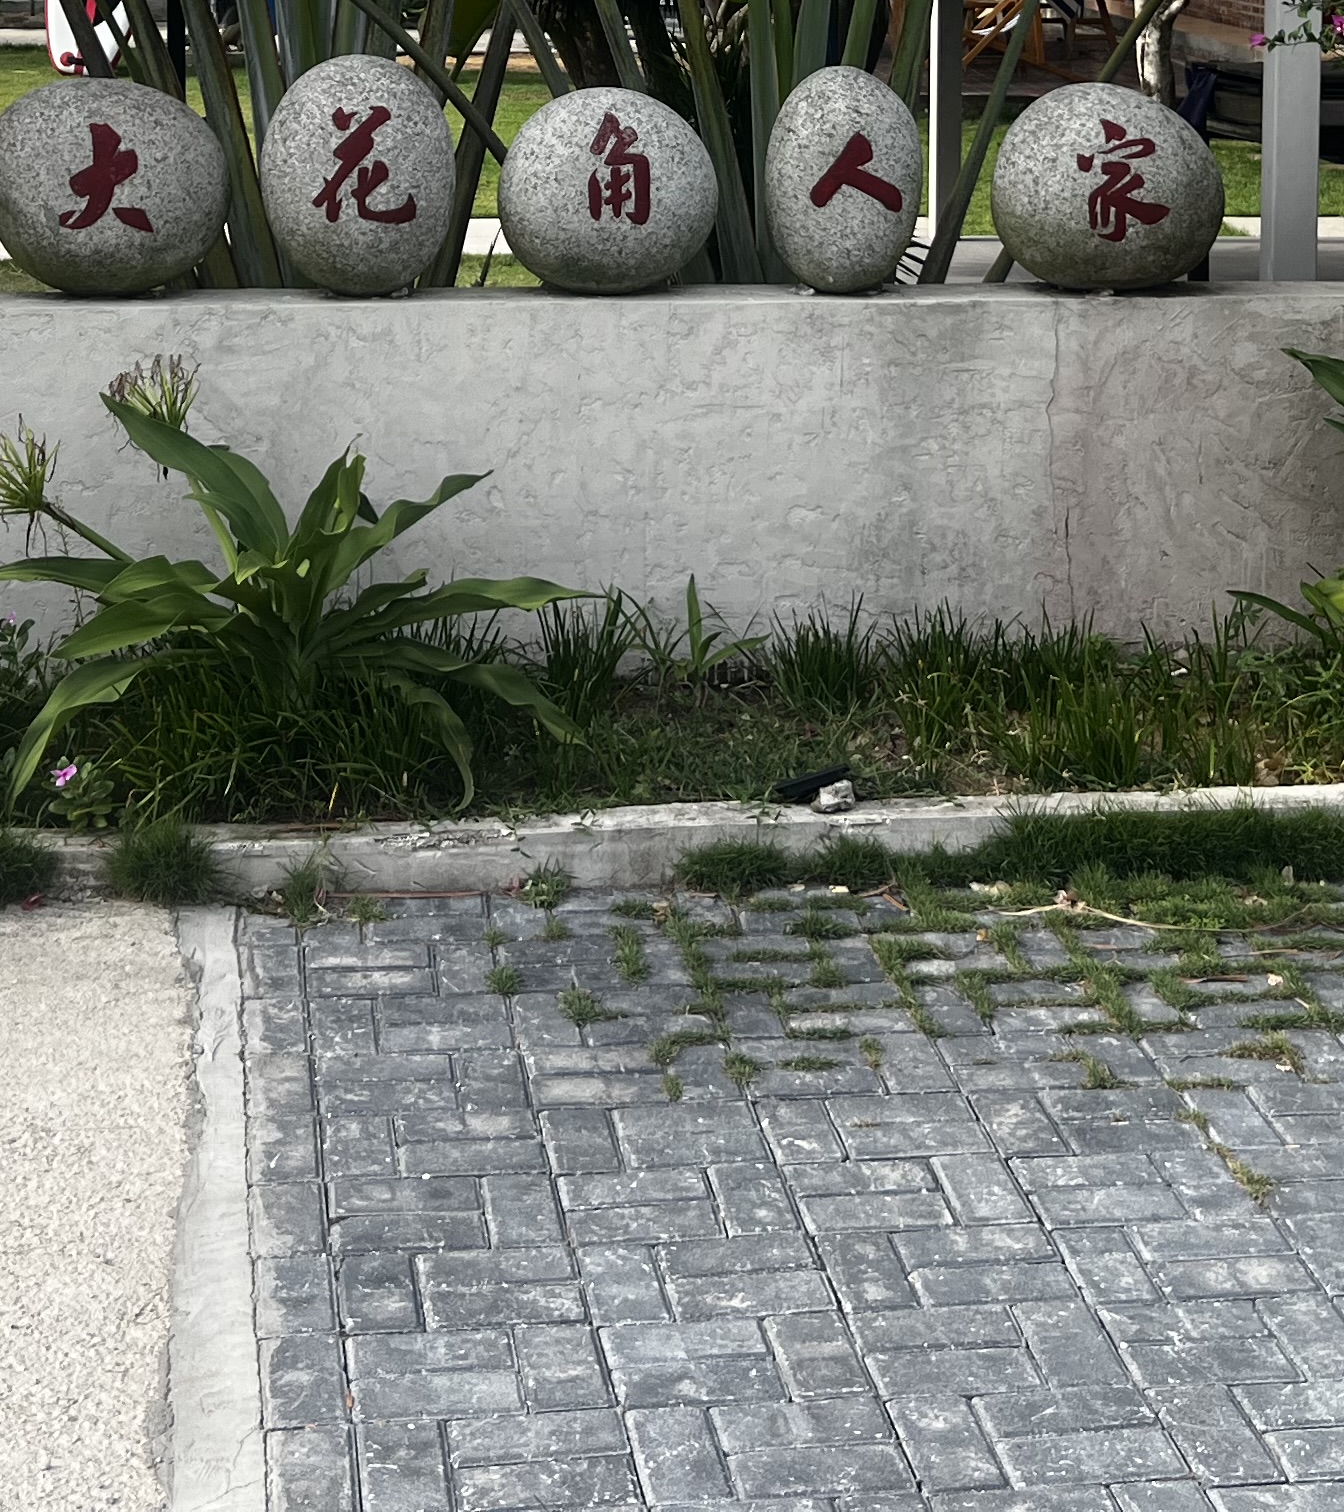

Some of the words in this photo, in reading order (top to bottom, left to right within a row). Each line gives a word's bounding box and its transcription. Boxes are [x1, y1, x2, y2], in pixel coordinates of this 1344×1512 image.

[59, 122, 154, 233] 大
[312, 105, 417, 224] 花
[588, 111, 651, 226] 角
[809, 131, 902, 213] 人
[1076, 118, 1171, 241] 家
